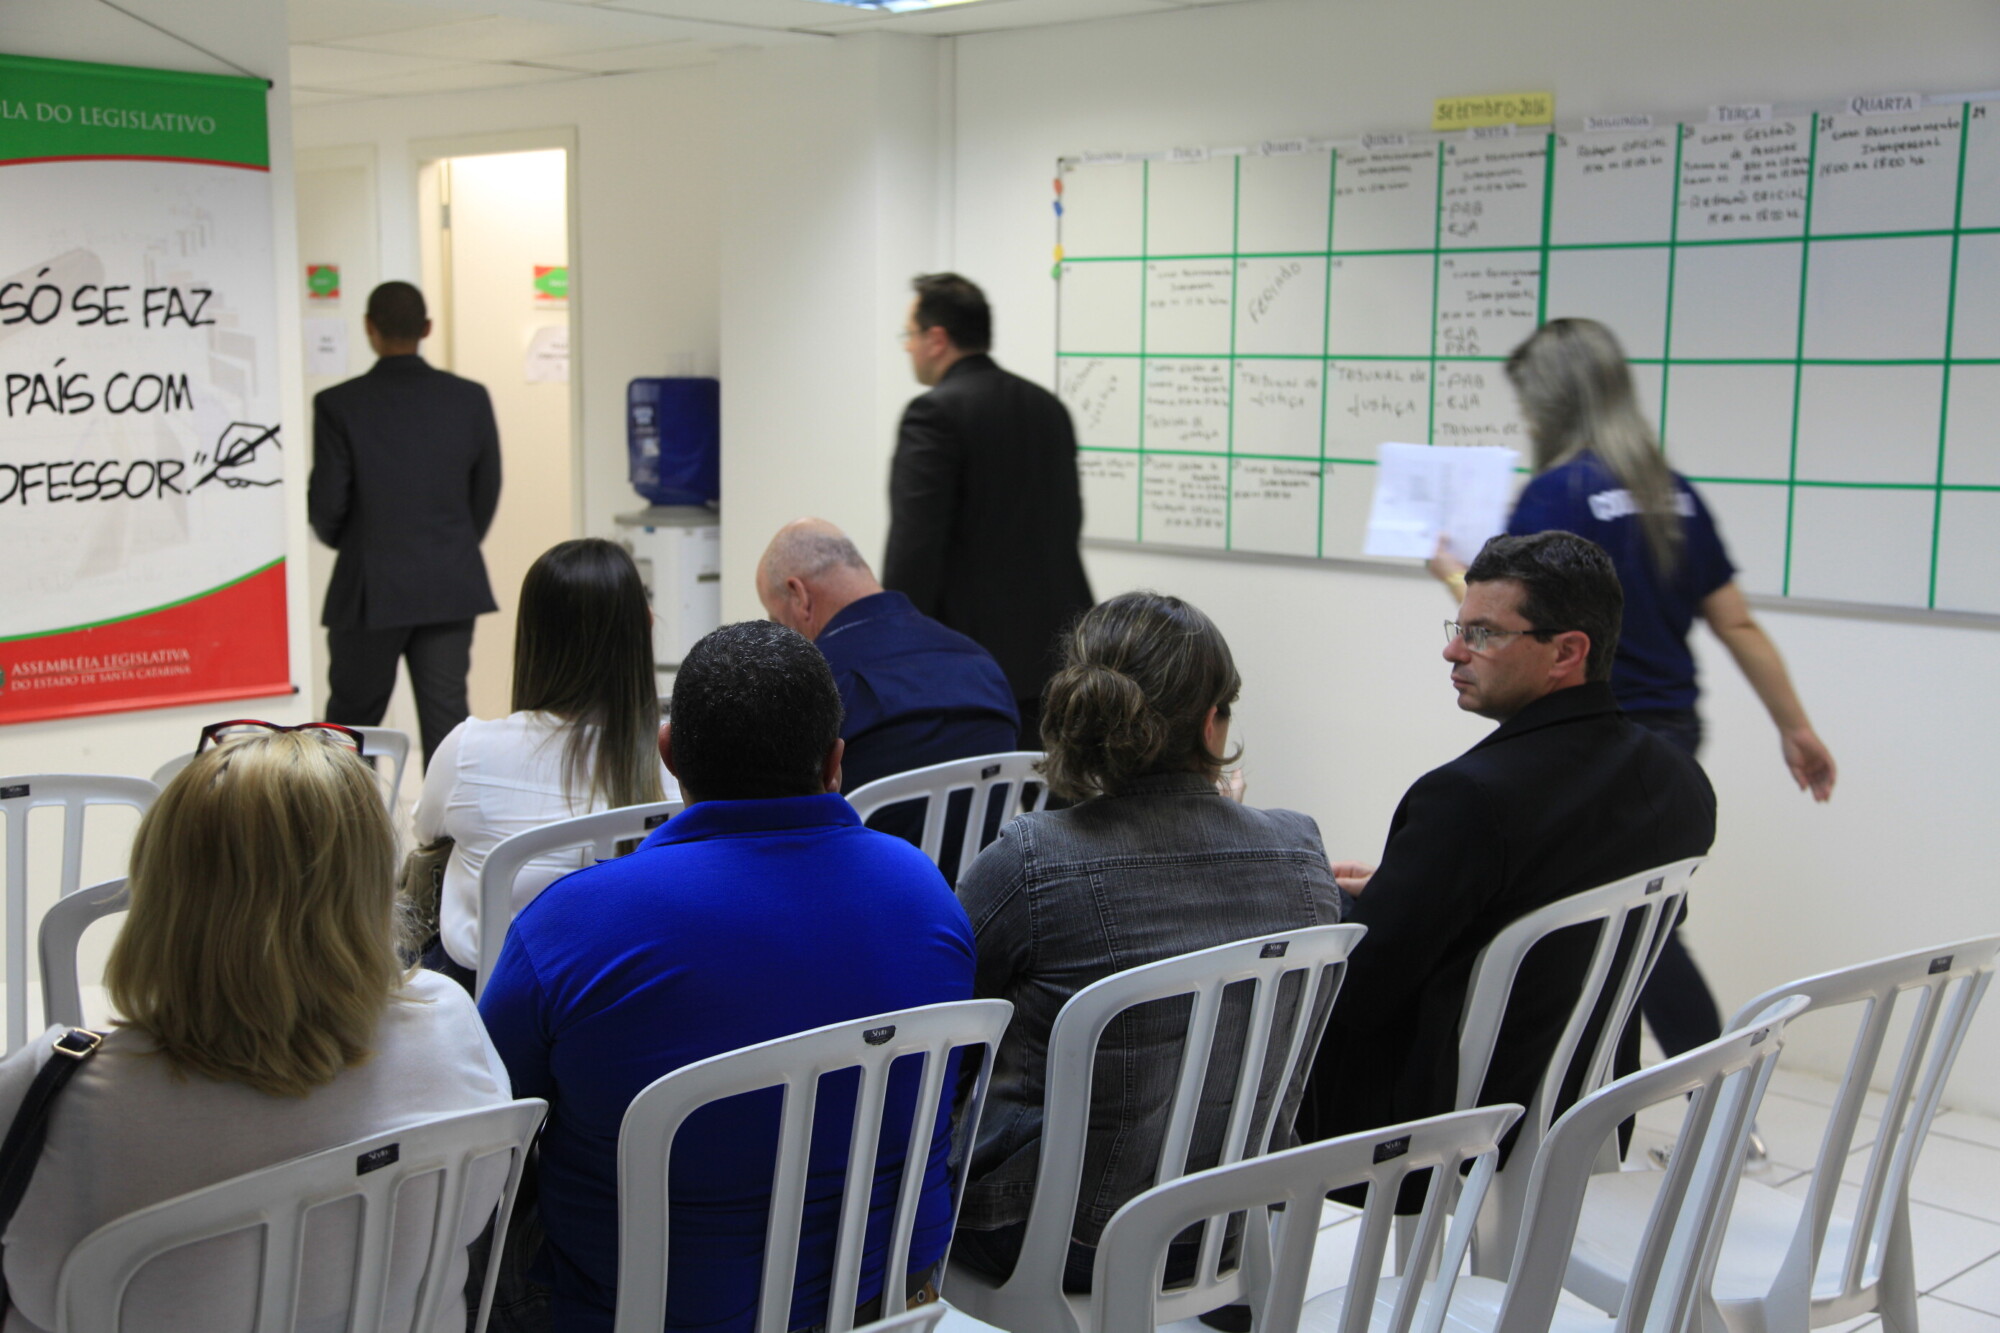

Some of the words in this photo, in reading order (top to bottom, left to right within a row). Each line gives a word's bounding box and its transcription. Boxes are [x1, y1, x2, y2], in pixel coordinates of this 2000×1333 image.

[36, 102, 73, 124] DO
[80, 106, 216, 134] LEGISLATIVO
[1718, 104, 1761, 122] TERÇA
[1851, 96, 1914, 114] QUARTA
[0, 267, 62, 325] SÓ
[72, 284, 131, 328] SE
[143, 285, 216, 329] FAZ
[5, 357, 95, 417] PAÍS
[104, 371, 194, 415] COM
[11, 654, 101, 677] ASSEMBLÉIA
[103, 647, 191, 669] LEGISLATIVA
[11, 678, 32, 692] DO
[34, 674, 79, 690] ESTADO
[81, 673, 97, 685] DE
[99, 669, 135, 683] SANTA
[136, 664, 191, 680] CATARINA
